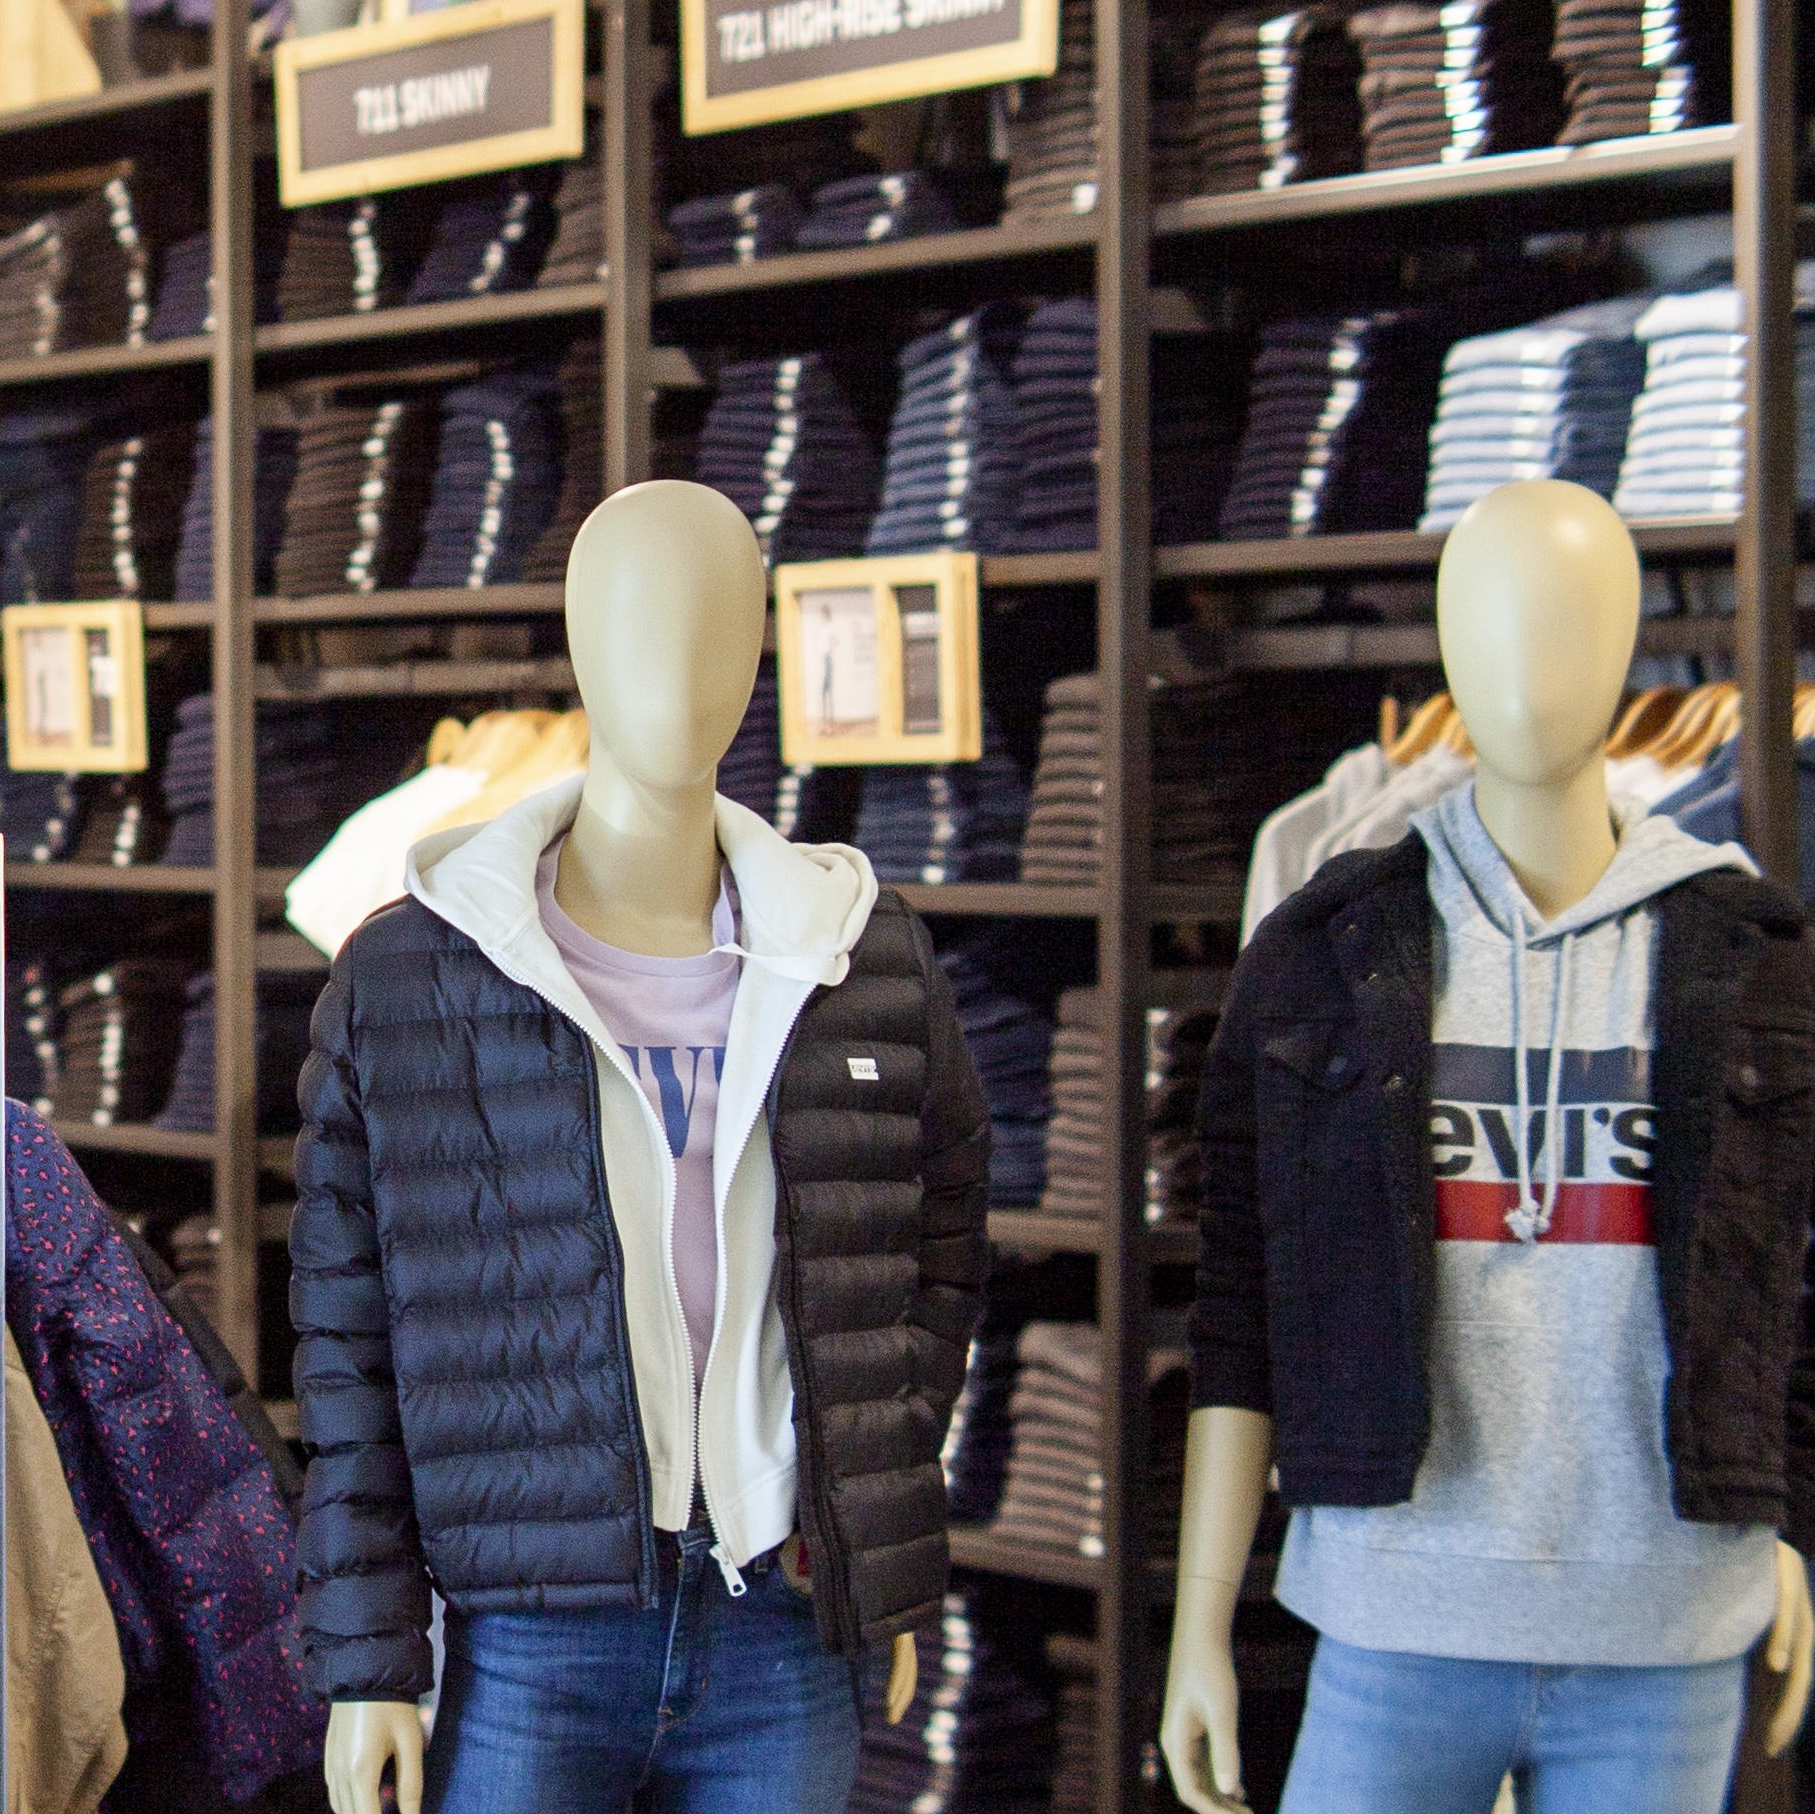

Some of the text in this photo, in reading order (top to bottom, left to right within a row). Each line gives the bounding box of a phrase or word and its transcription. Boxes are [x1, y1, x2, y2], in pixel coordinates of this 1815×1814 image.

[717, 9, 766, 63] 721
[354, 65, 491, 134] 711 SKINNY
